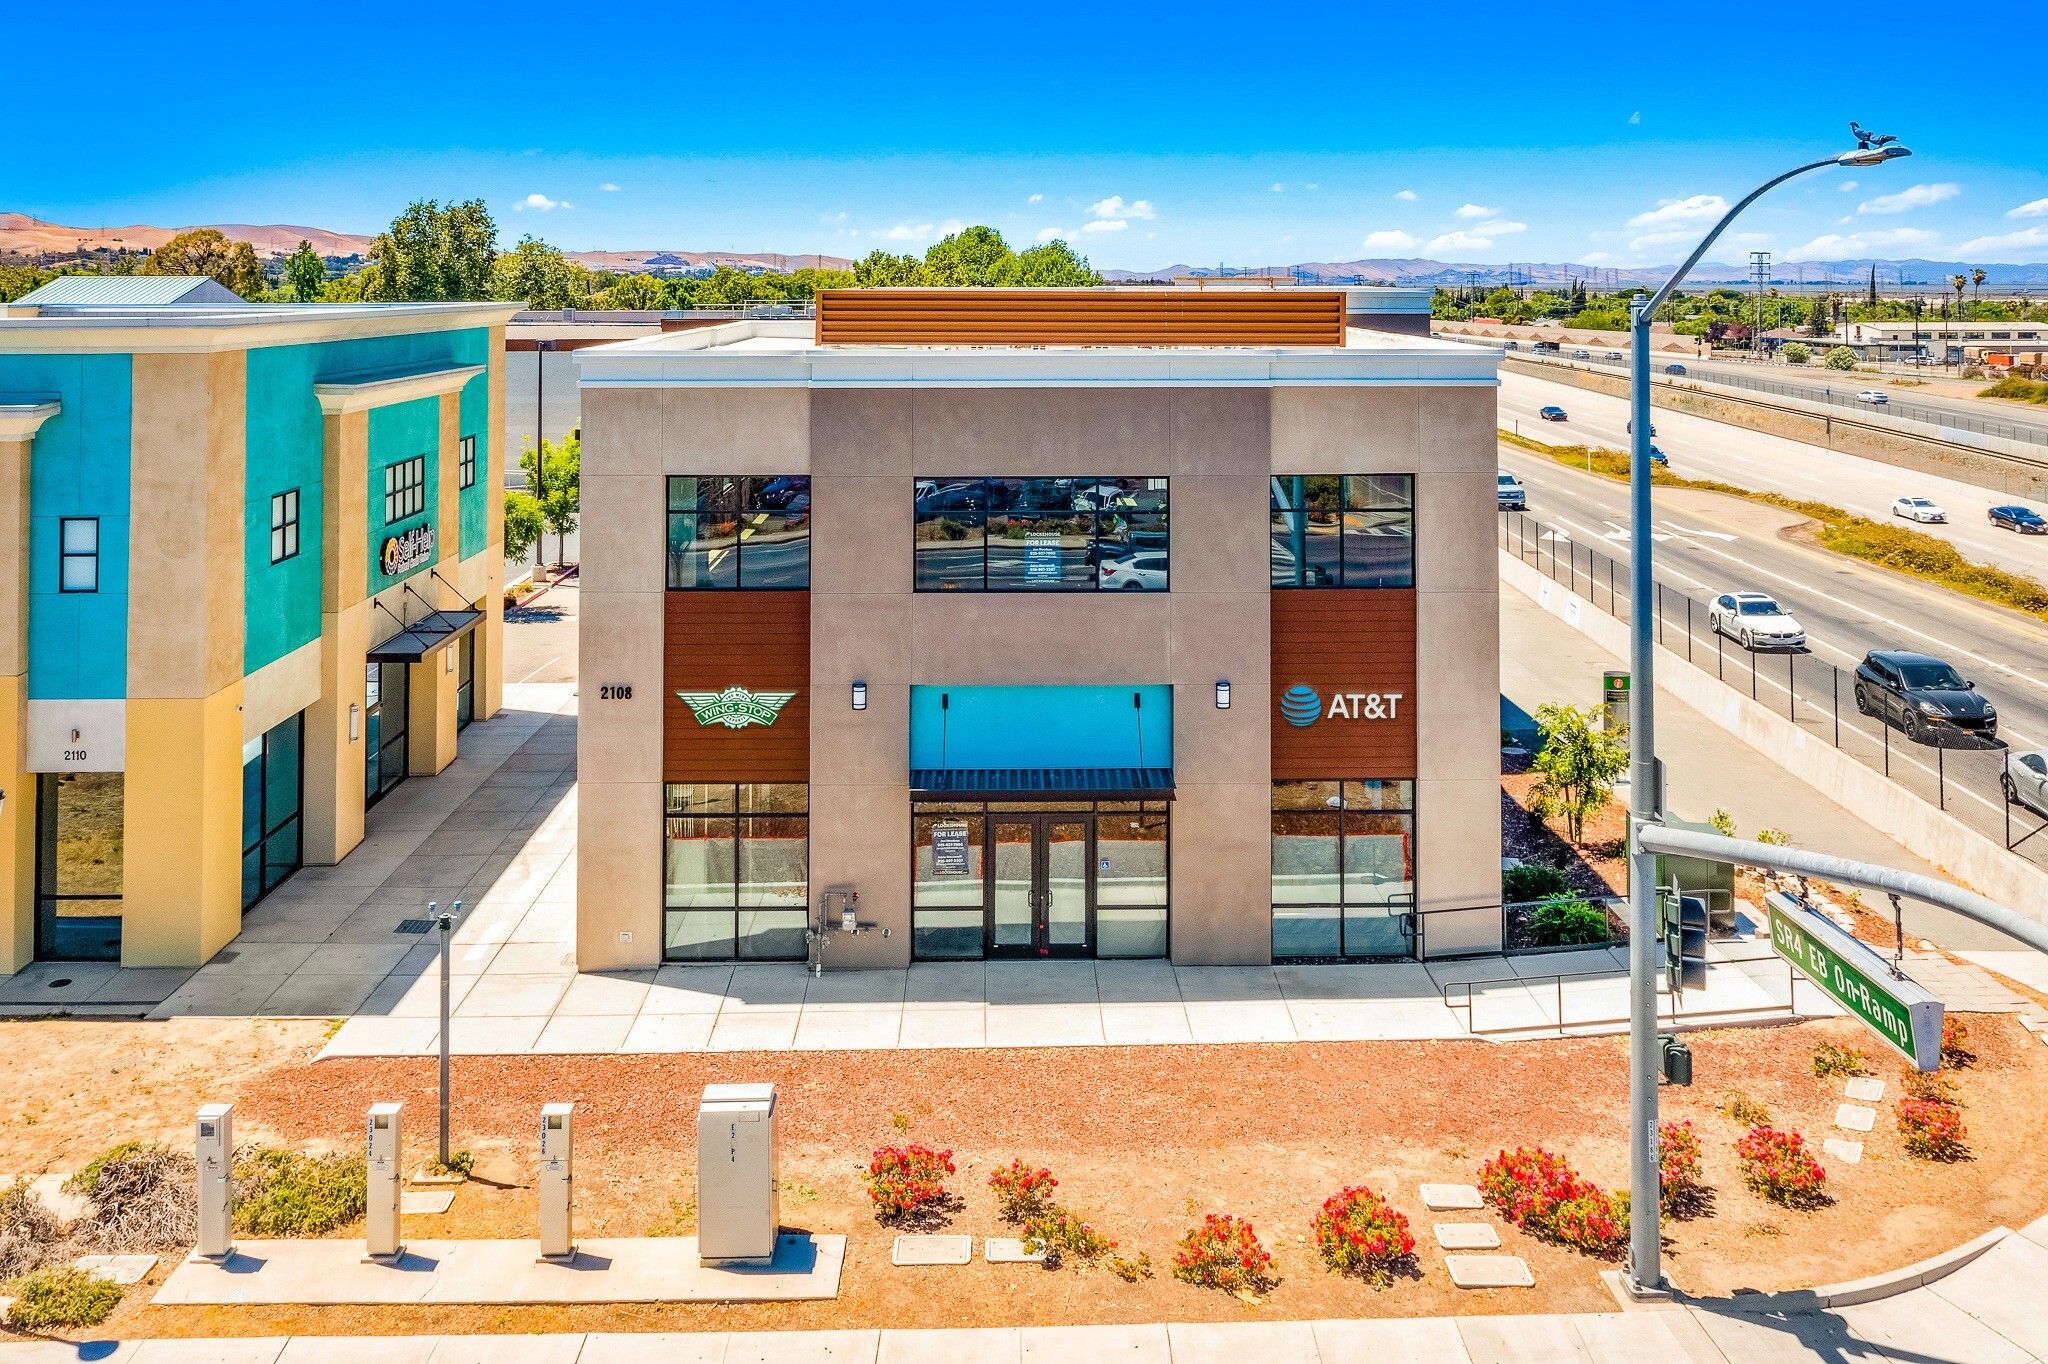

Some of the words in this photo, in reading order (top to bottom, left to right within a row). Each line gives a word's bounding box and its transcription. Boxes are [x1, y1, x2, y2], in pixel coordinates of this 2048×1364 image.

[600, 686, 632, 700] 2108
[1327, 693, 1403, 719] AT&T
[63, 750, 87, 761] 2110
[1775, 918, 1803, 960] SR4
[1808, 943, 1828, 979] EB
[1834, 964, 1908, 1047] On-Ramp
